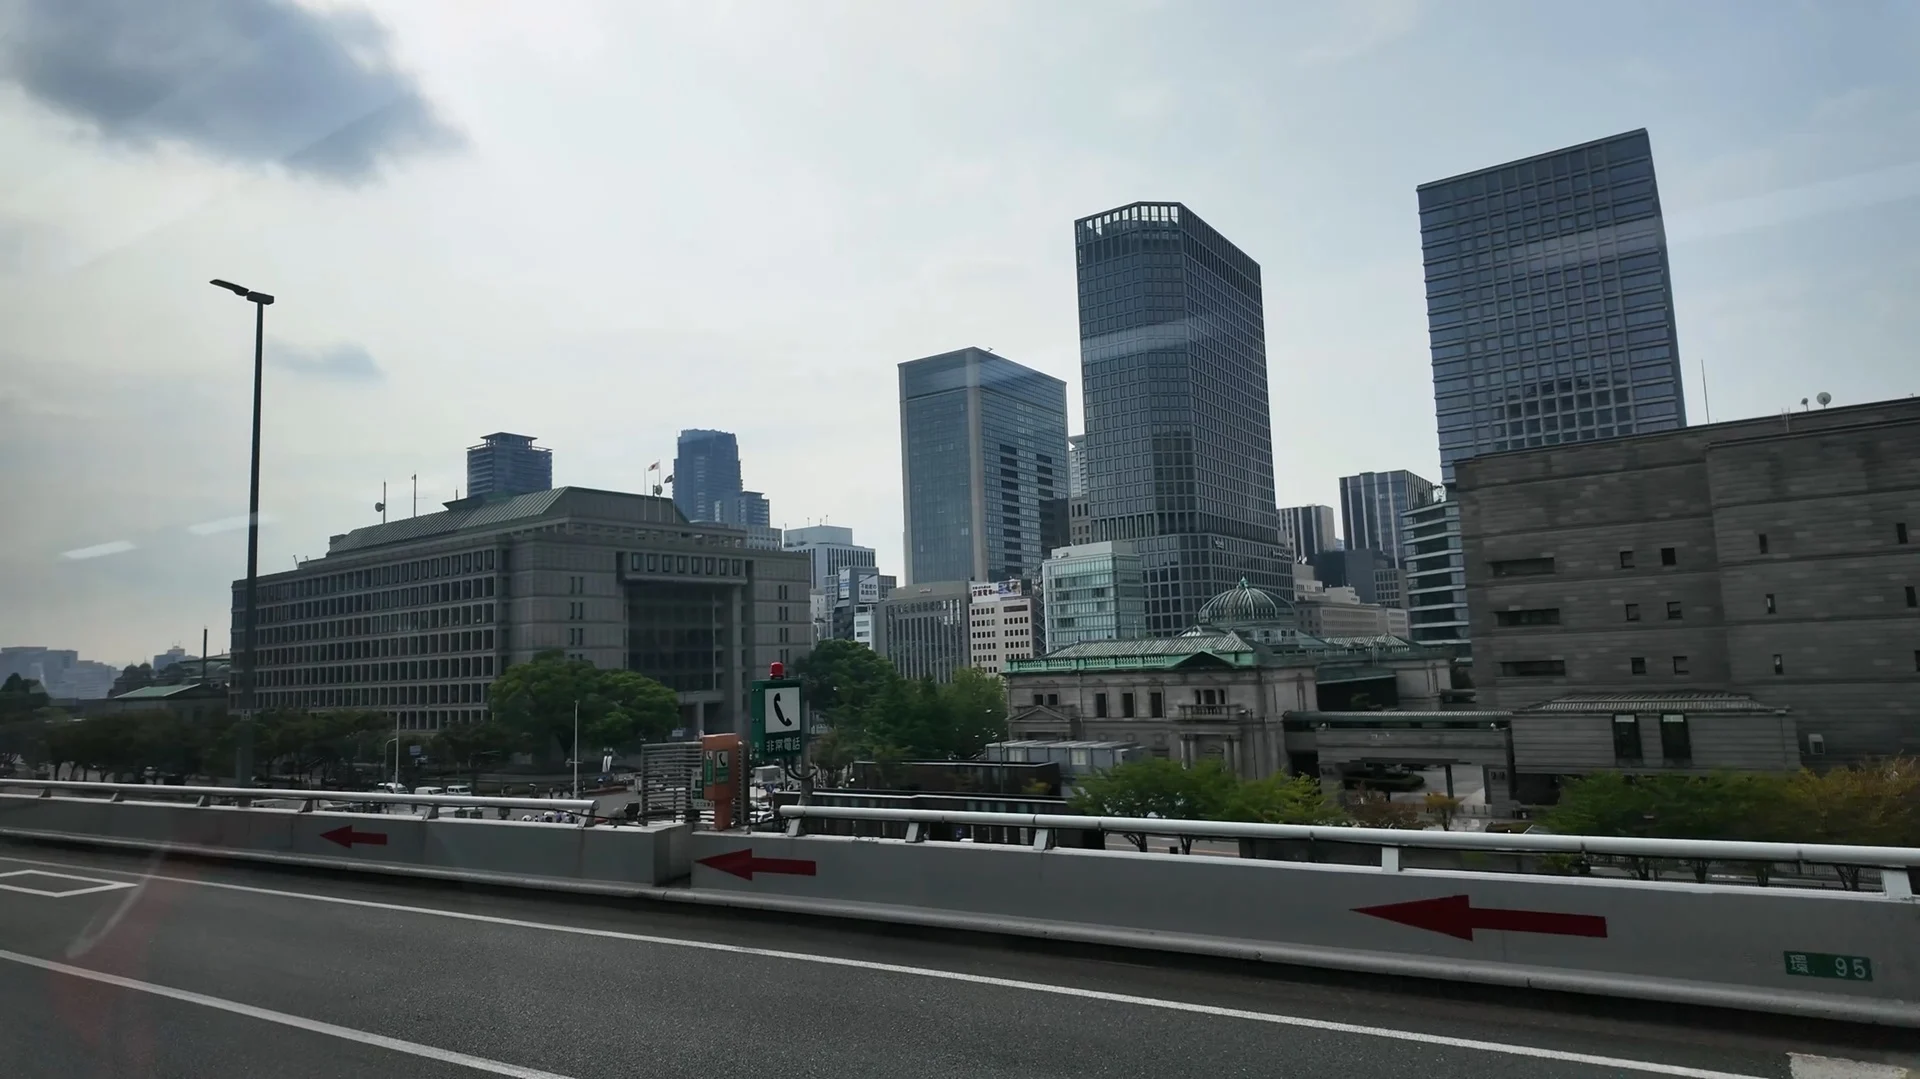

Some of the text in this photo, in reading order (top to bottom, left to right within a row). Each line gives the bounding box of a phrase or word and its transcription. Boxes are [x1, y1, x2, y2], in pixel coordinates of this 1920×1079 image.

[766, 737, 801, 752] 非常電話
[1789, 954, 1866, 979] 環 95
